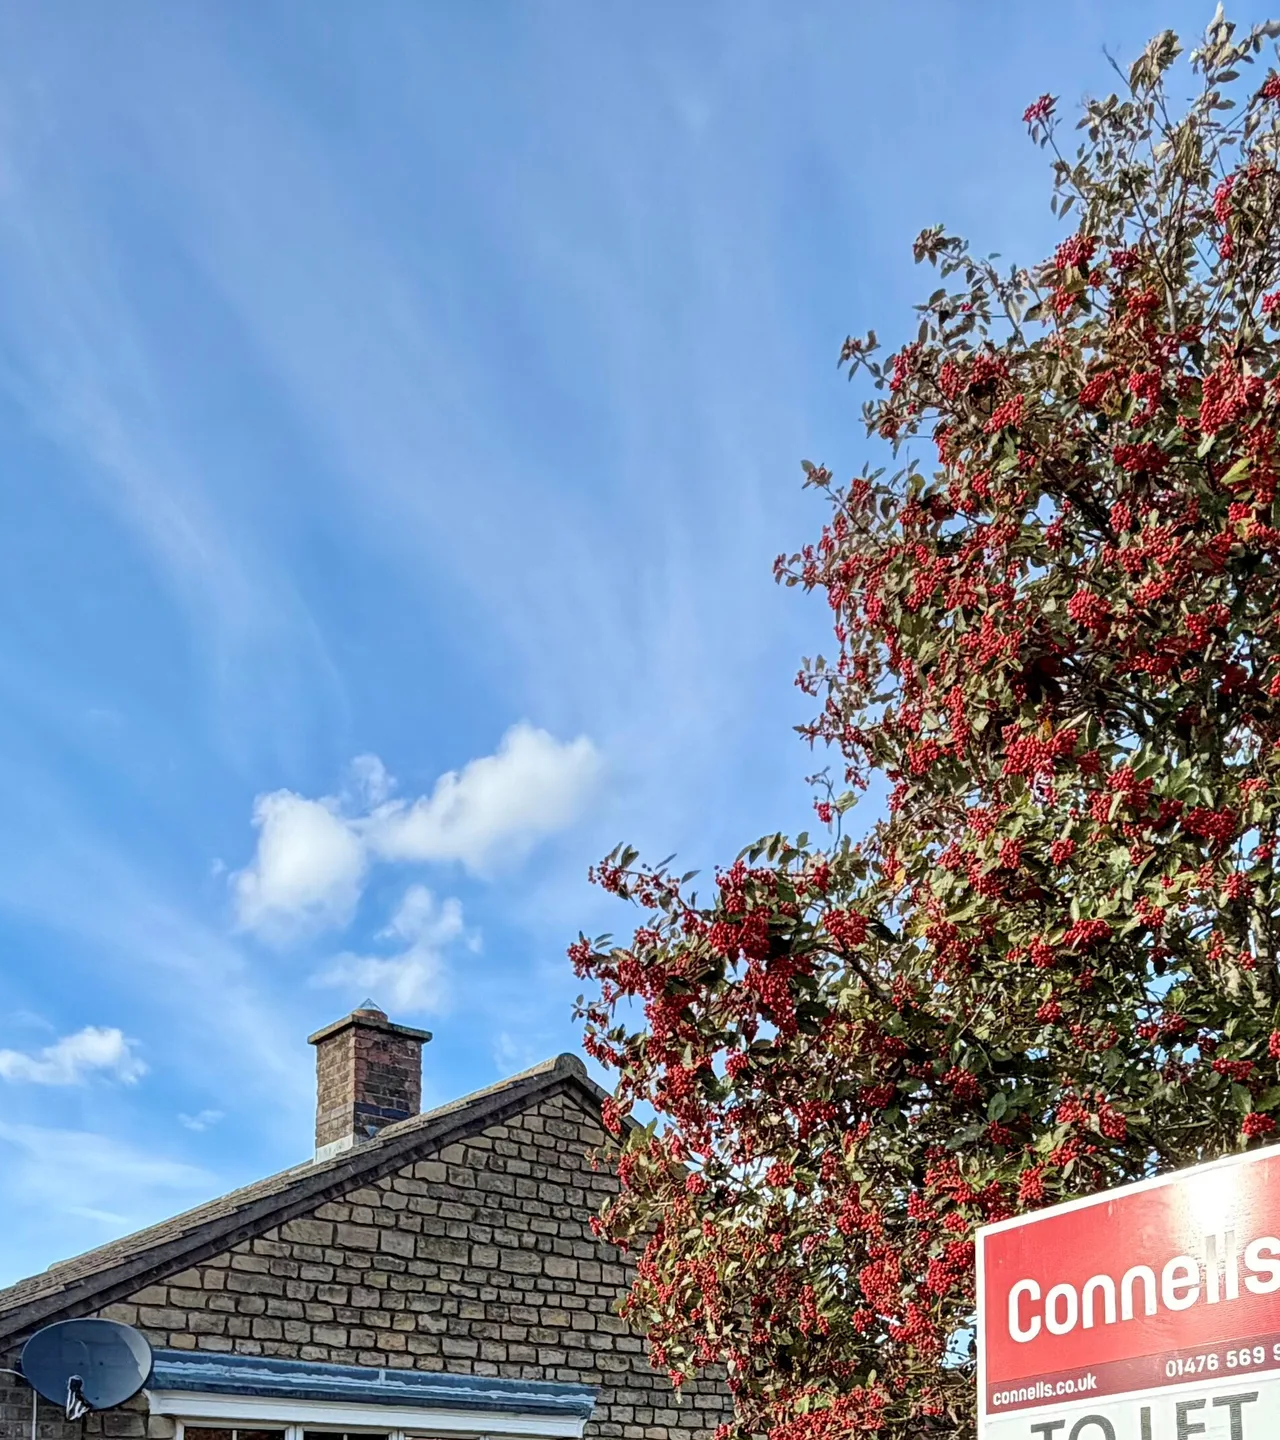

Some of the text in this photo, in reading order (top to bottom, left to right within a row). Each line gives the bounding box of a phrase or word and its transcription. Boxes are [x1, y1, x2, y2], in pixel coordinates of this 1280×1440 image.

[1165, 1353, 1219, 1377] 01476
[1226, 1346, 1266, 1368] 569
[992, 1372, 1098, 1406] connells.co.uk
